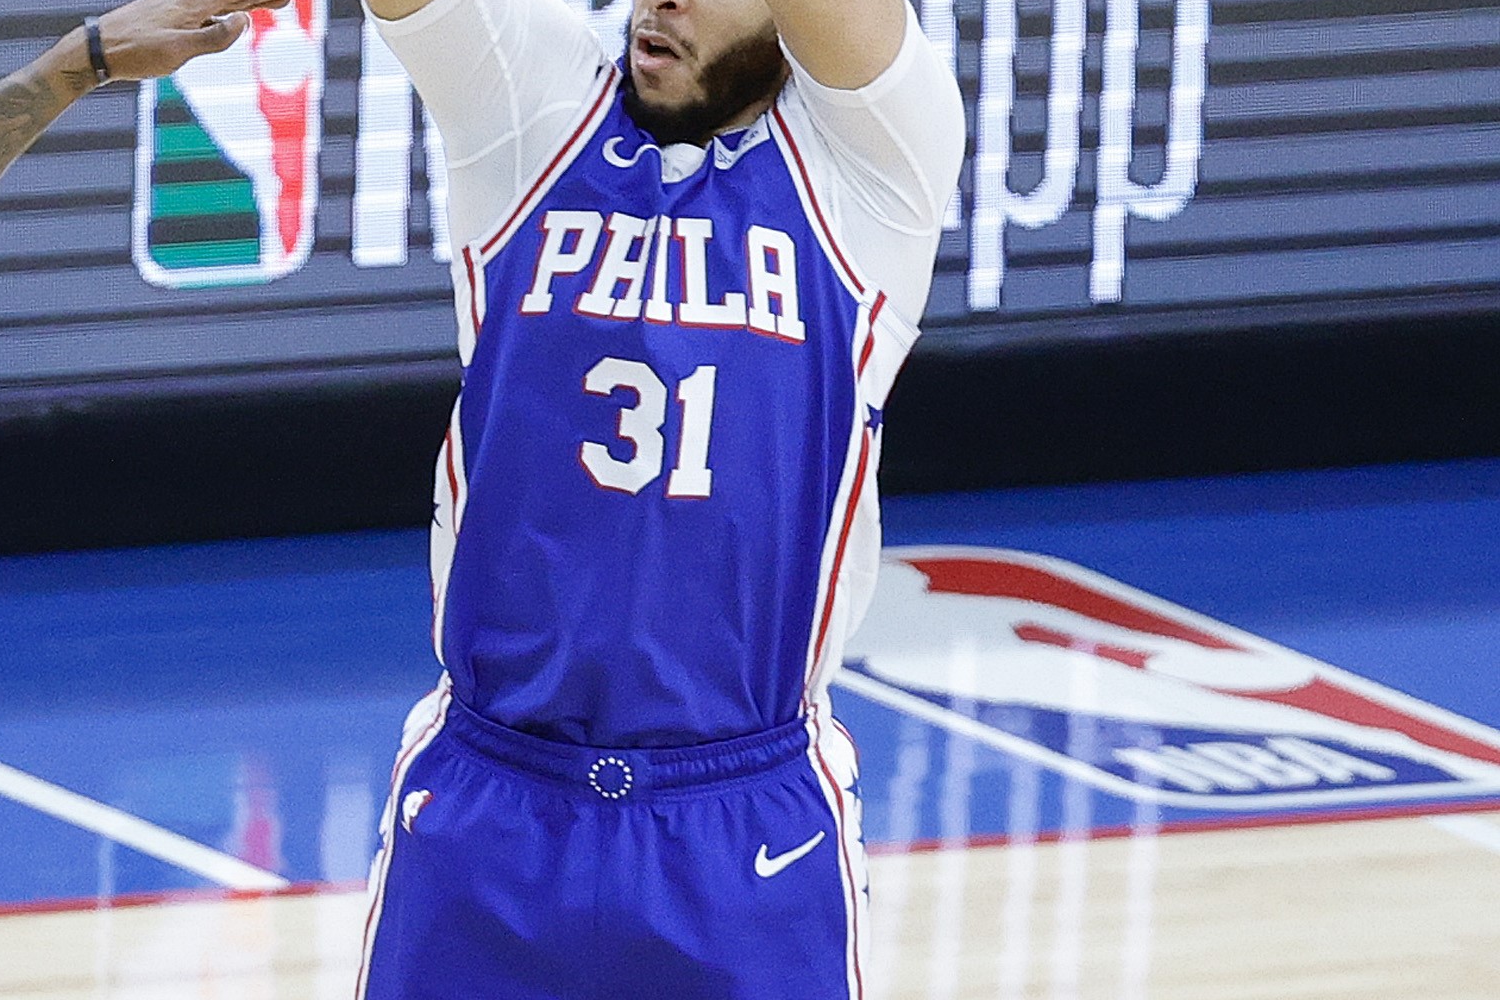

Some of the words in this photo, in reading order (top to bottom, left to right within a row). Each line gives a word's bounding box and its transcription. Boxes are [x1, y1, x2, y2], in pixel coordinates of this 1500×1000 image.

[518, 210, 806, 345] PHILA
[578, 356, 717, 500] 31
[1111, 735, 1398, 793] NBA
